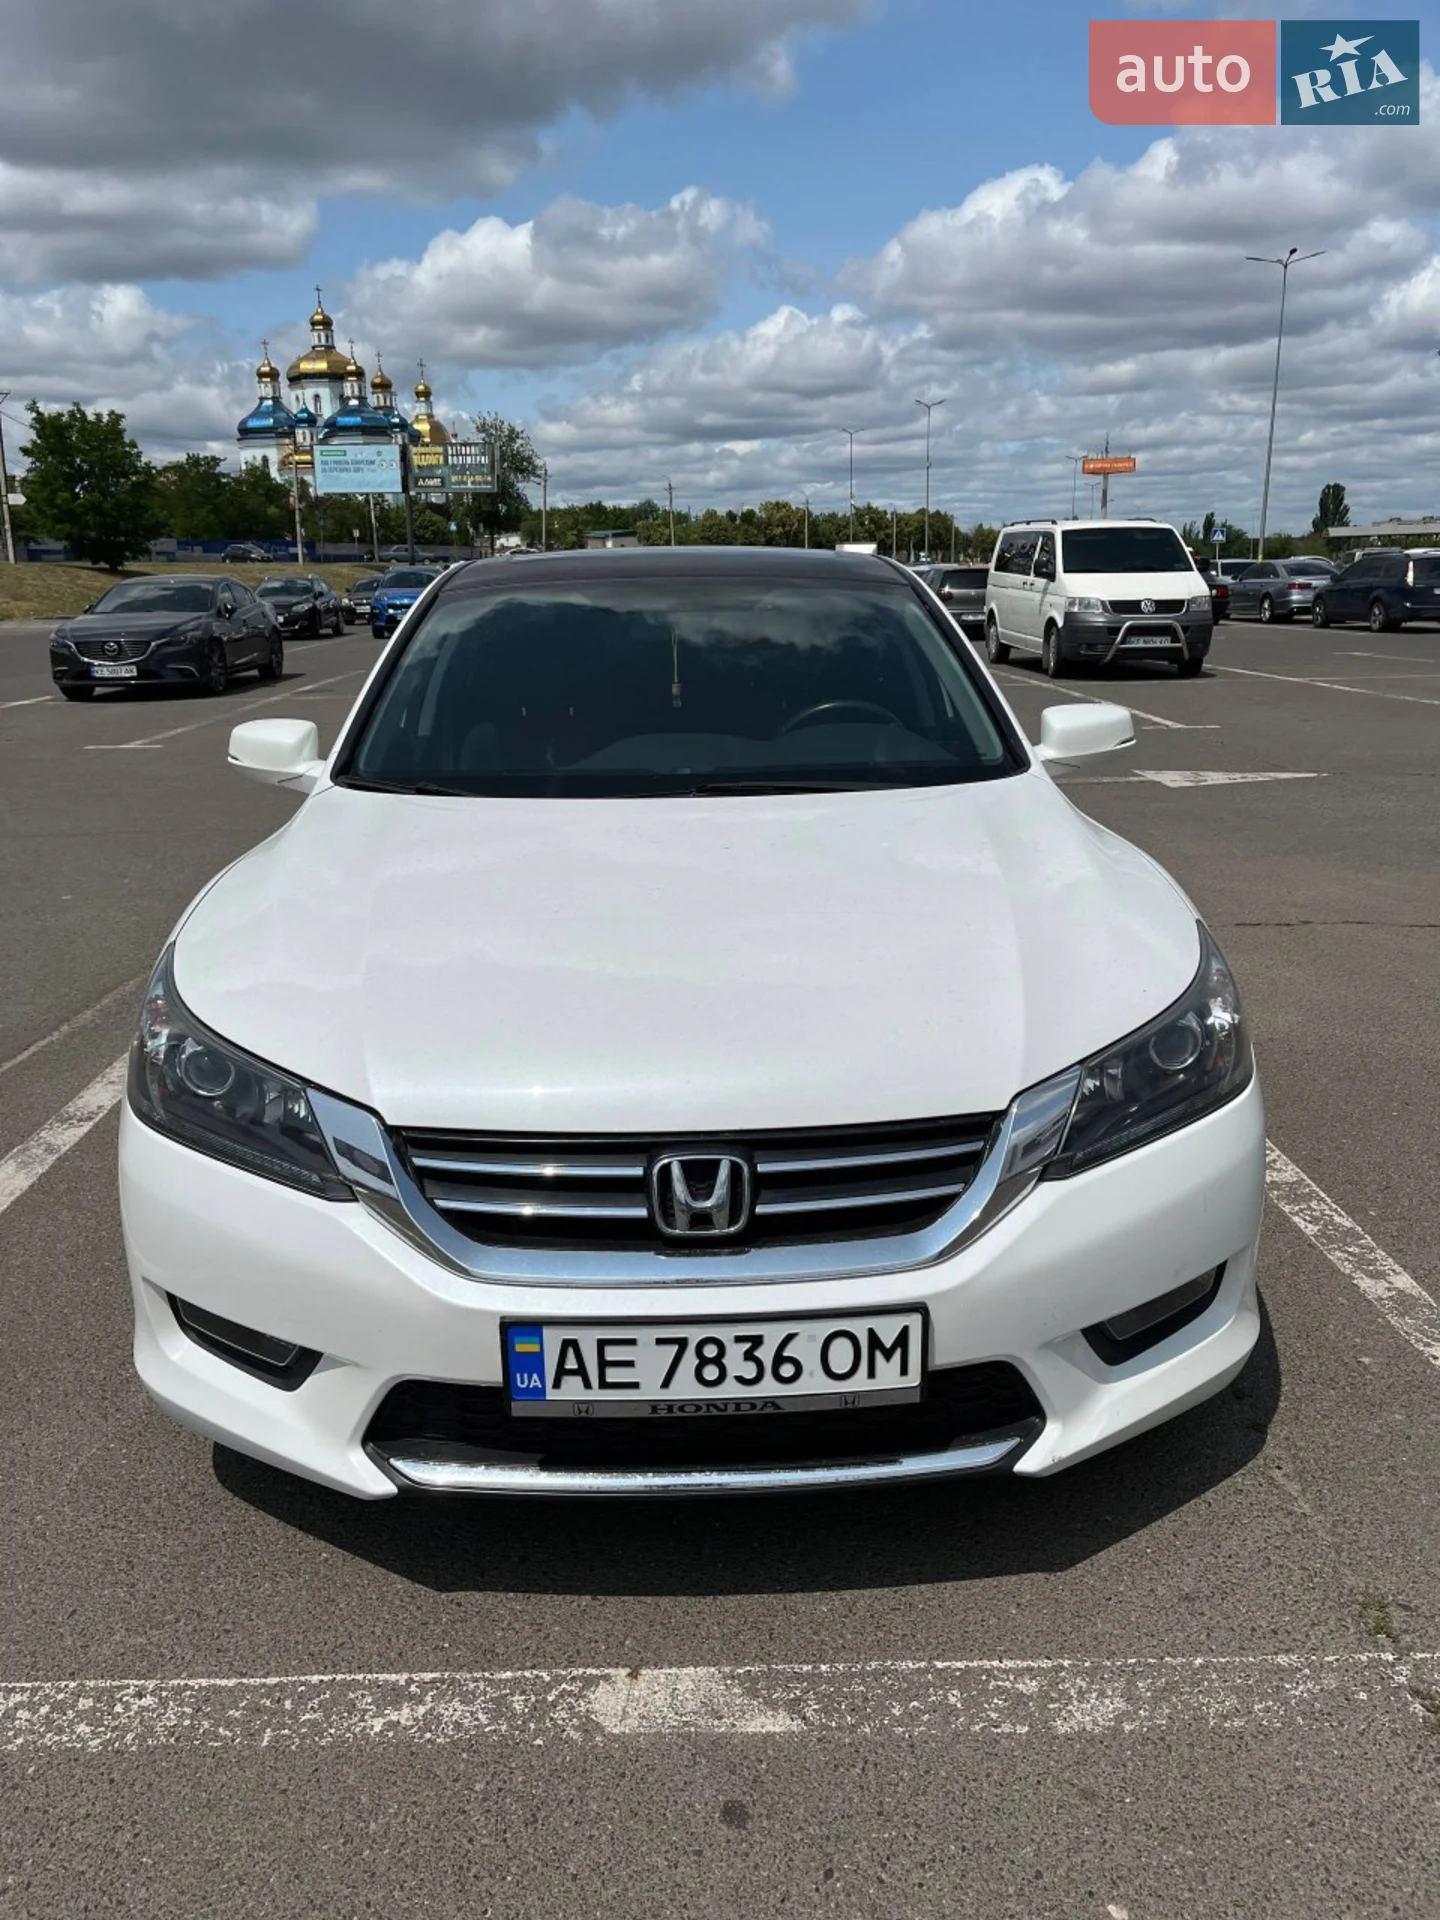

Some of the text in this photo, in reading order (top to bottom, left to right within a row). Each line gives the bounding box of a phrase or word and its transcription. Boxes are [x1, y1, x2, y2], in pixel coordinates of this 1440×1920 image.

[551, 1324, 910, 1390] AE 7836 OM
[516, 1372, 542, 1389] UA
[648, 1401, 784, 1415] HONDA
